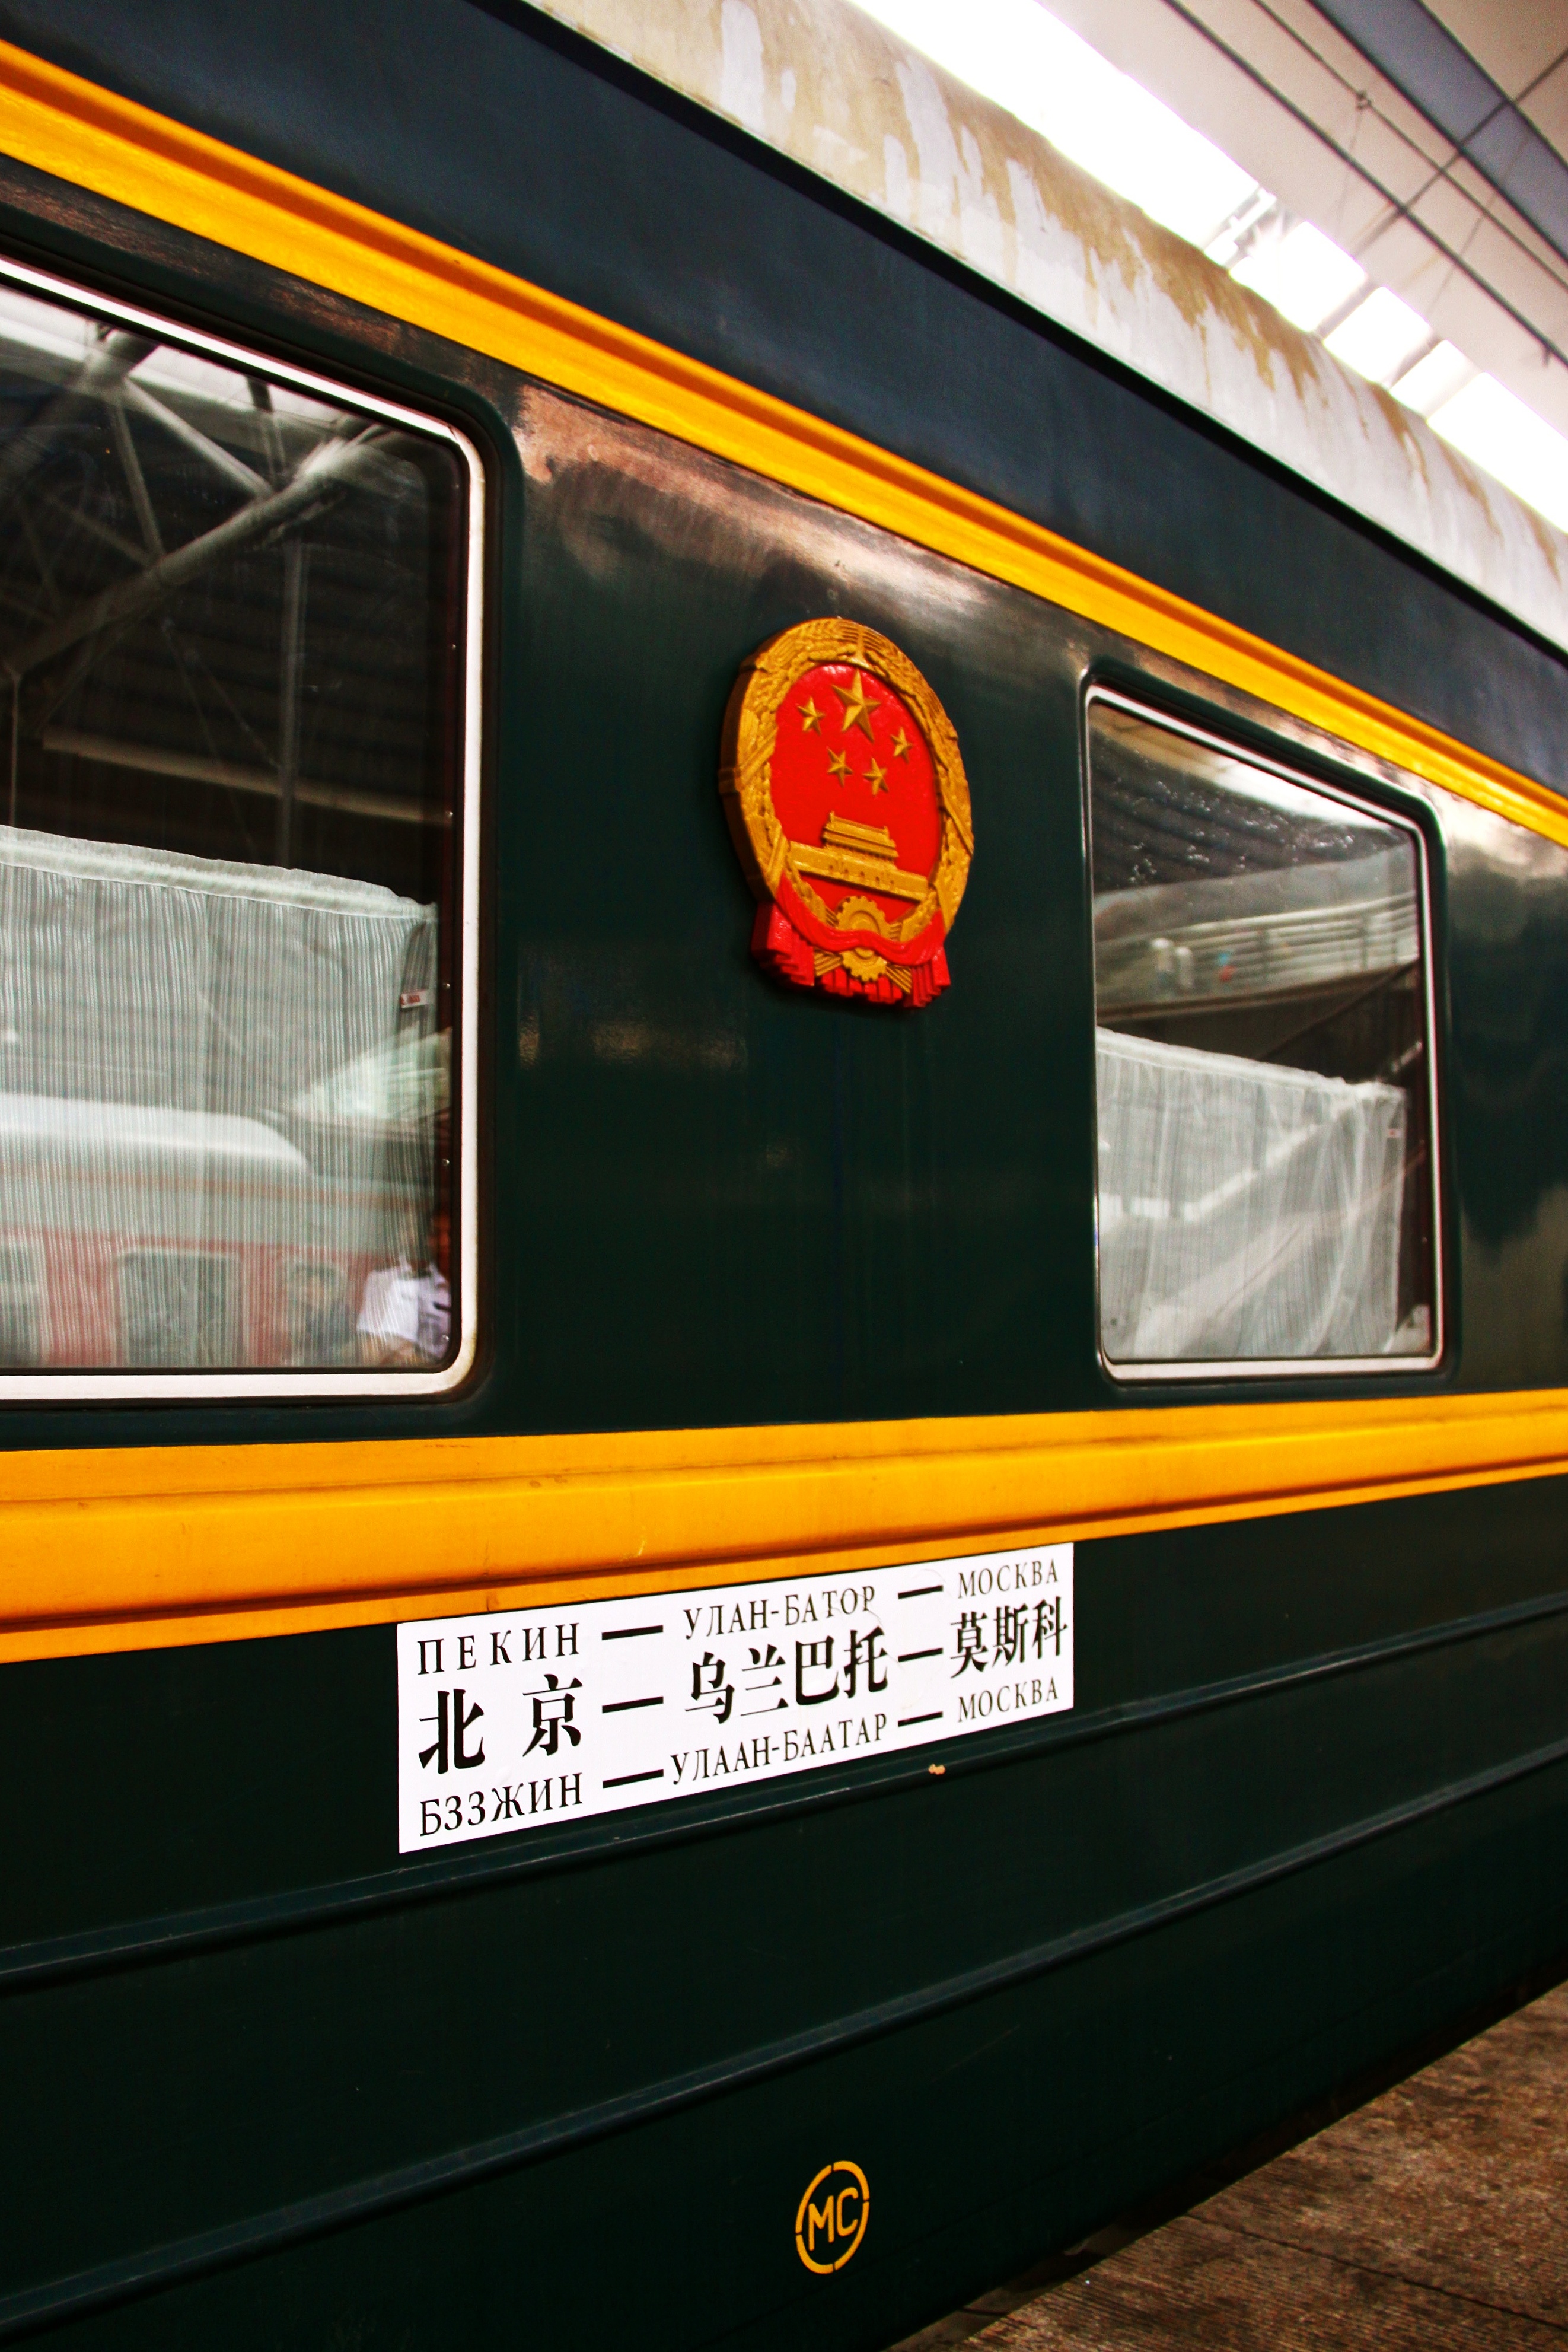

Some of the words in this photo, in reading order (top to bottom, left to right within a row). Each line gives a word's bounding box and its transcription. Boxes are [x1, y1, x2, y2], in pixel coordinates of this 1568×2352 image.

[417, 1622, 579, 1675] ПЕКИН
[683, 1586, 875, 1640] УЛАН-БАТОР
[958, 1558, 1059, 1599] МОСКВА
[418, 1673, 583, 1775] 北京
[685, 1626, 888, 1724] 乌兰巴托
[951, 1596, 1067, 1679] 莫斯科
[671, 1713, 887, 1785] УЛААН-БААТАР
[958, 1676, 1059, 1723] МОСКВА
